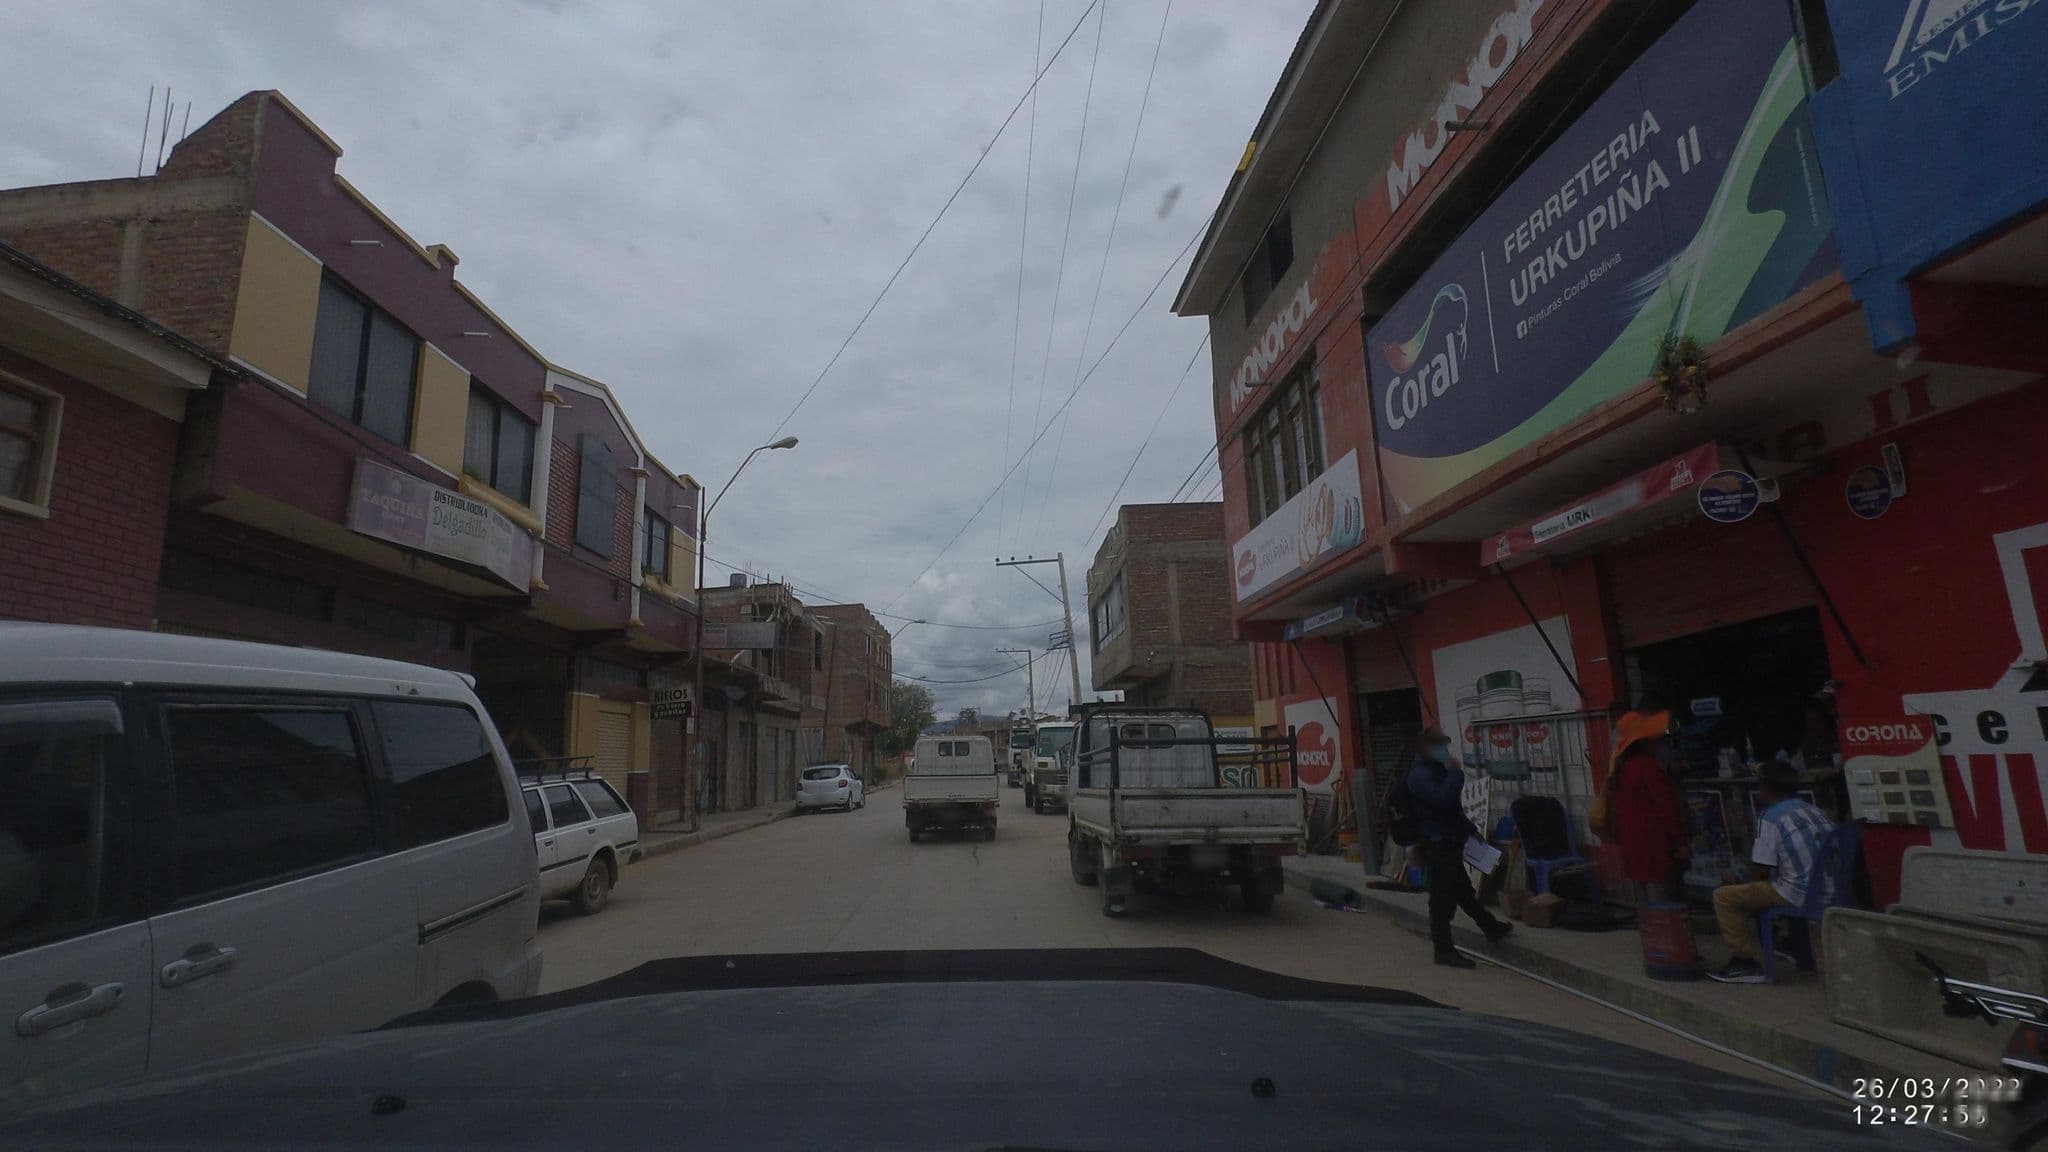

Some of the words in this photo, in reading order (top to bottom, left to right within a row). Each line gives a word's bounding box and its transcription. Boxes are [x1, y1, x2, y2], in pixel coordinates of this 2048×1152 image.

[1887, 0, 2041, 102] EMIS
[1504, 109, 1661, 264] FERRETERIA
[1510, 159, 1671, 306] URKUPIÑA
[1676, 125, 1702, 175] II
[1528, 297, 1562, 329] Pinturas
[1563, 274, 1590, 301] Coral
[1590, 252, 1623, 283] Bolivia
[1231, 281, 1317, 413] MONOPOL
[1385, 333, 1460, 431] Coral
[1846, 723, 1924, 743] CORONA
